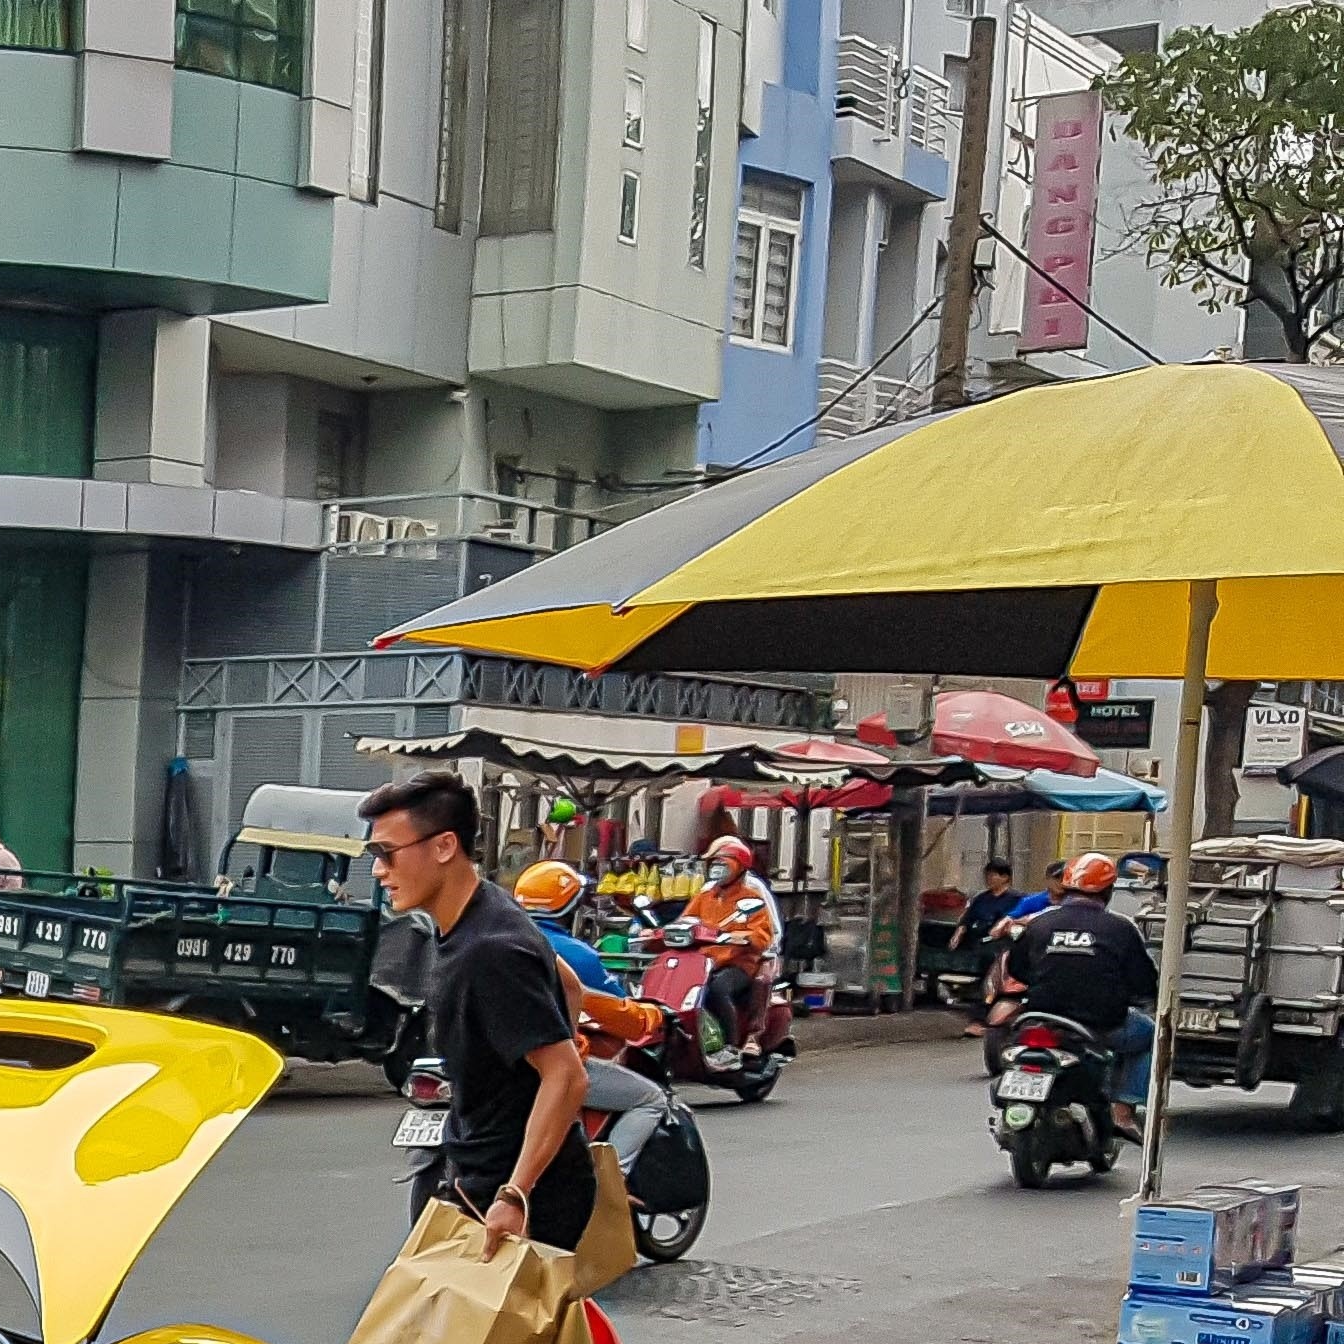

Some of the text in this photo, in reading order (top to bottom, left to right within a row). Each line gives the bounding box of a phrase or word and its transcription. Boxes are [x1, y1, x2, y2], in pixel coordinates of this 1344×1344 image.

[1255, 709, 1300, 725] VLXD
[35, 920, 63, 942] 429
[82, 927, 106, 950] 770
[1053, 932, 1095, 947] FILA
[224, 943, 252, 961] 429
[270, 945, 295, 965] 770
